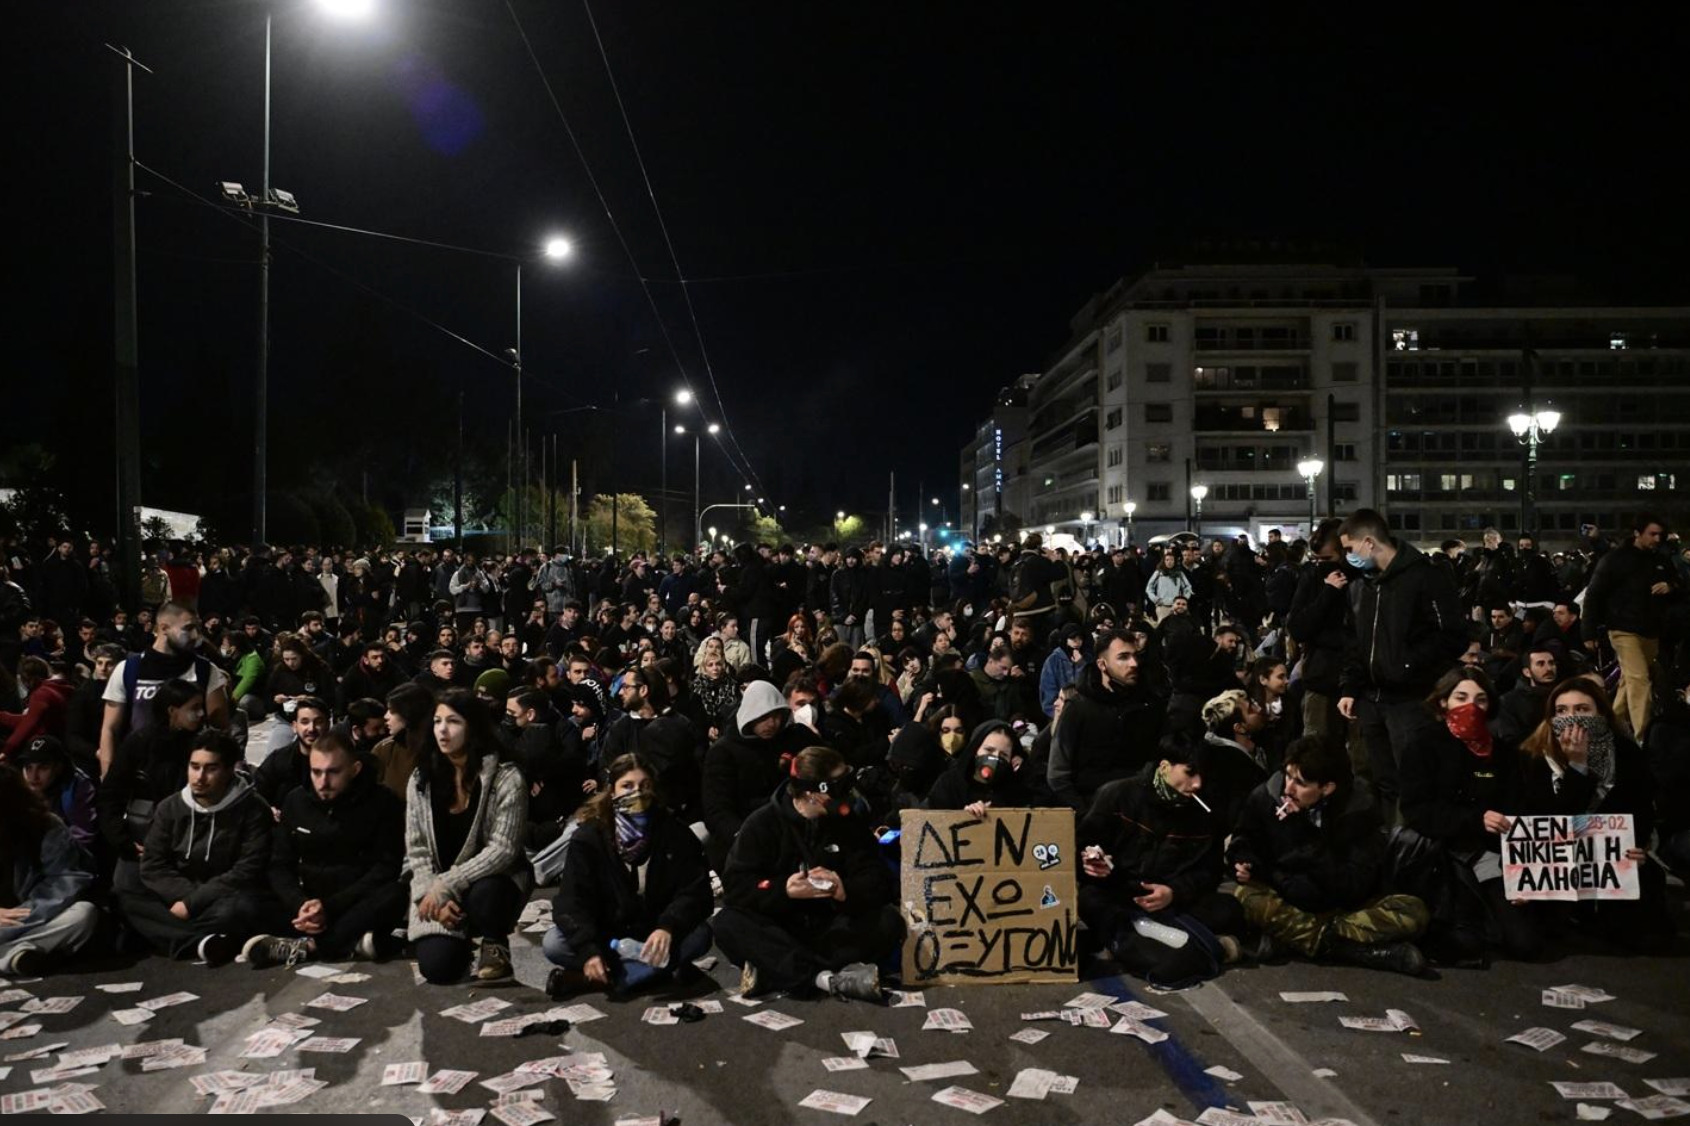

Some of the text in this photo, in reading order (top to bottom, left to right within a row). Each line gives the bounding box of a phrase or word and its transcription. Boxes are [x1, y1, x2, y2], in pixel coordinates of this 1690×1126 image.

[915, 813, 1032, 868] ΔΕΝ
[1506, 816, 1567, 841] ΔΕΝ
[1604, 836, 1622, 861] Η
[1517, 862, 1621, 892] ΑΛΗΘΕΙΑ
